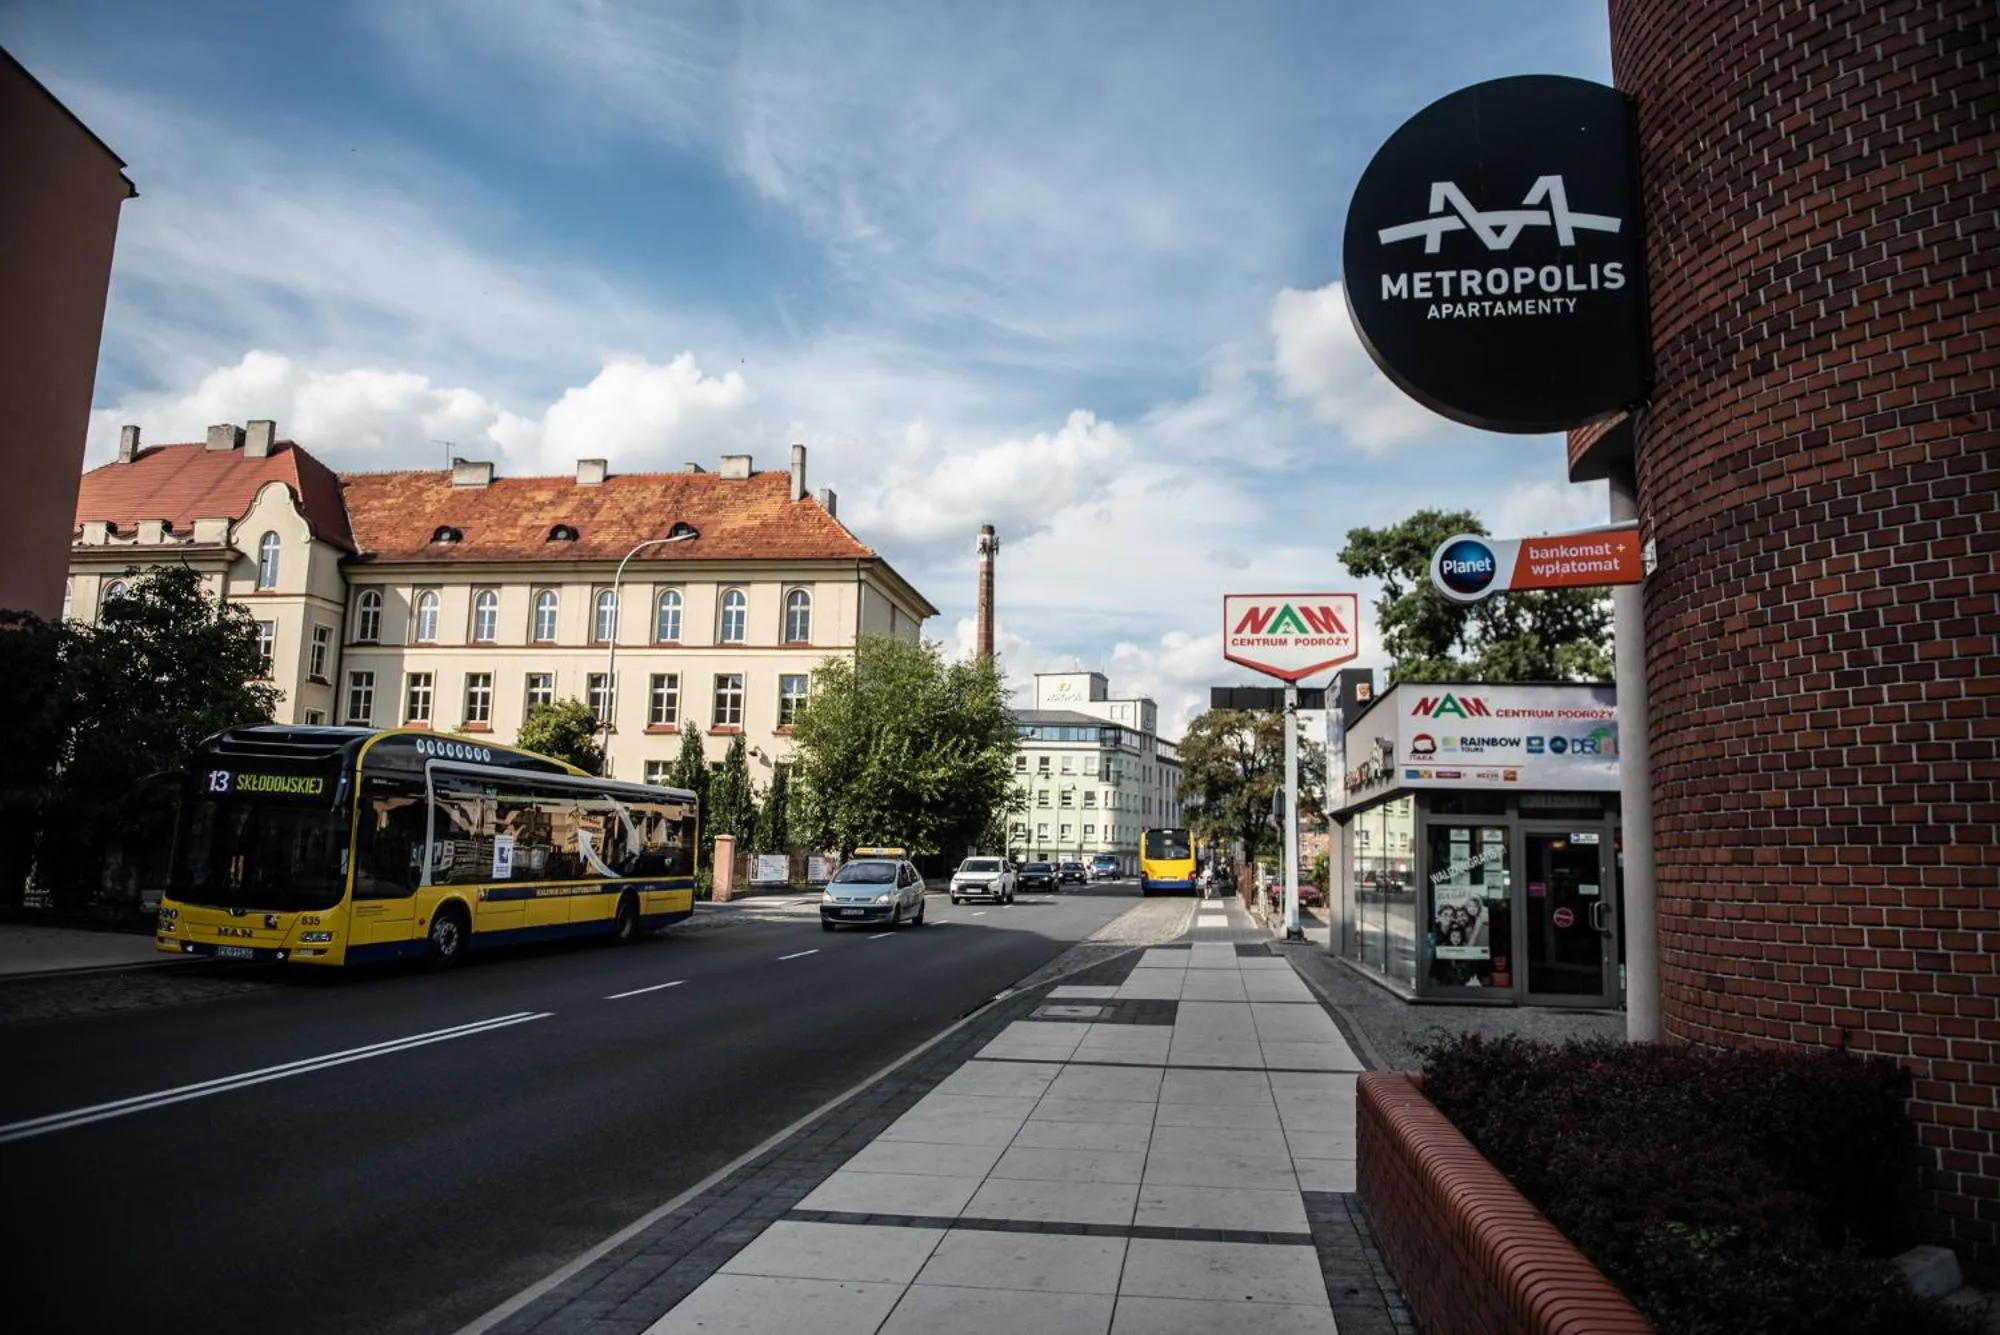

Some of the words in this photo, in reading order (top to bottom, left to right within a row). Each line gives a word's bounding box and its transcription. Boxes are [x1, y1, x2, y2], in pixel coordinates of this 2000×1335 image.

[1381, 262, 1626, 300] METROPOLIS
[1427, 297, 1578, 320] APARTAMENTY
[1529, 542, 1612, 560] bankomat
[1442, 557, 1492, 575] Planet
[1531, 556, 1621, 576] wpłatomat
[1233, 603, 1348, 634] NAM
[1231, 638, 1288, 646] CENTRUM
[1411, 692, 1492, 719] NAM
[1495, 709, 1554, 718] CENTRUM
[1460, 736, 1521, 747] RAINBOW
[207, 770, 230, 792] 13
[236, 773, 323, 795] SKŁODOWSKIEJ
[217, 927, 253, 939] MAN
